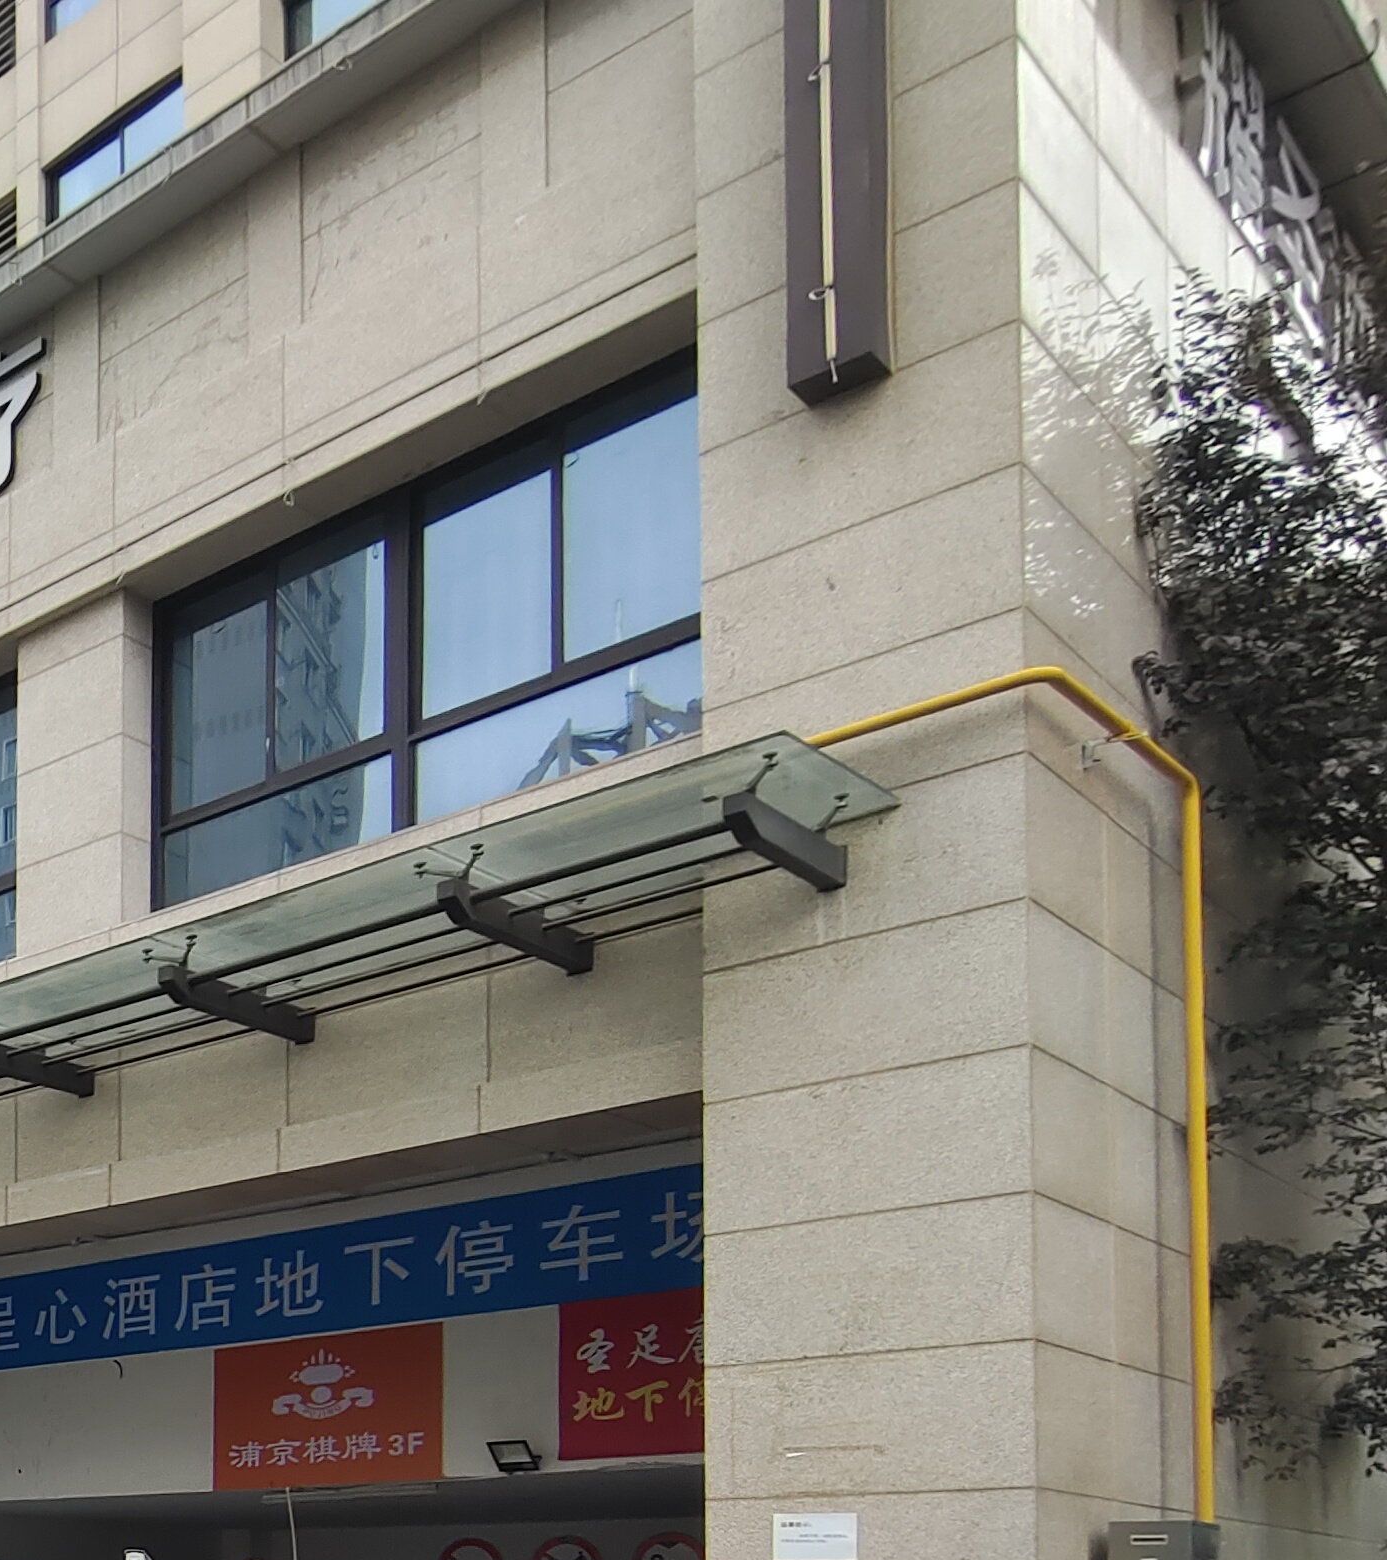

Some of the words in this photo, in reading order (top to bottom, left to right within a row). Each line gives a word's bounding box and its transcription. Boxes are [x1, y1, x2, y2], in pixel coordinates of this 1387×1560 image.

[229, 1432, 382, 1468] 浦京棋牌
[388, 1431, 425, 1456] 3F
